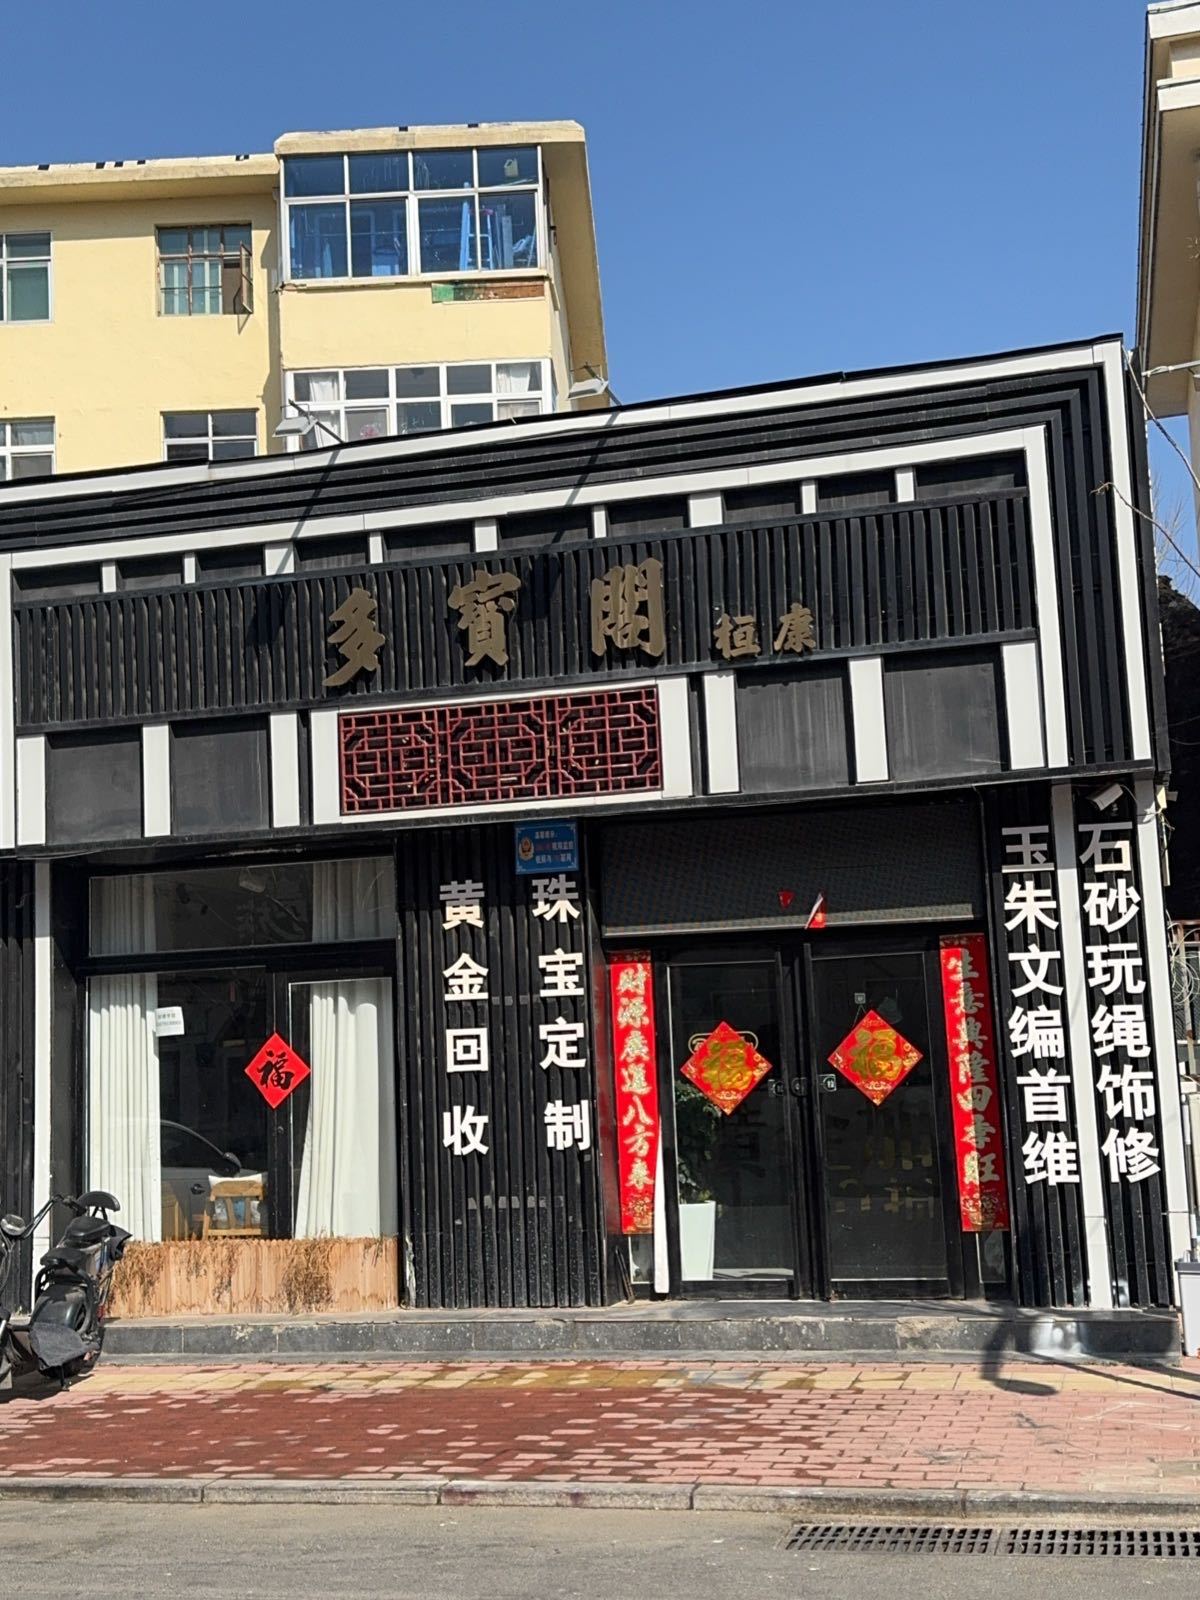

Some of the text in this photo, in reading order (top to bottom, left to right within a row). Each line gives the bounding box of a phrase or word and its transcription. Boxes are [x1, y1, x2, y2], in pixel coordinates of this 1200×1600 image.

[439, 880, 489, 1156] 黄金回收
[532, 874, 591, 1151] 珠宝定制
[257, 1051, 295, 1090] 福
[703, 1040, 753, 1091] 福
[849, 1029, 903, 1081] 福
